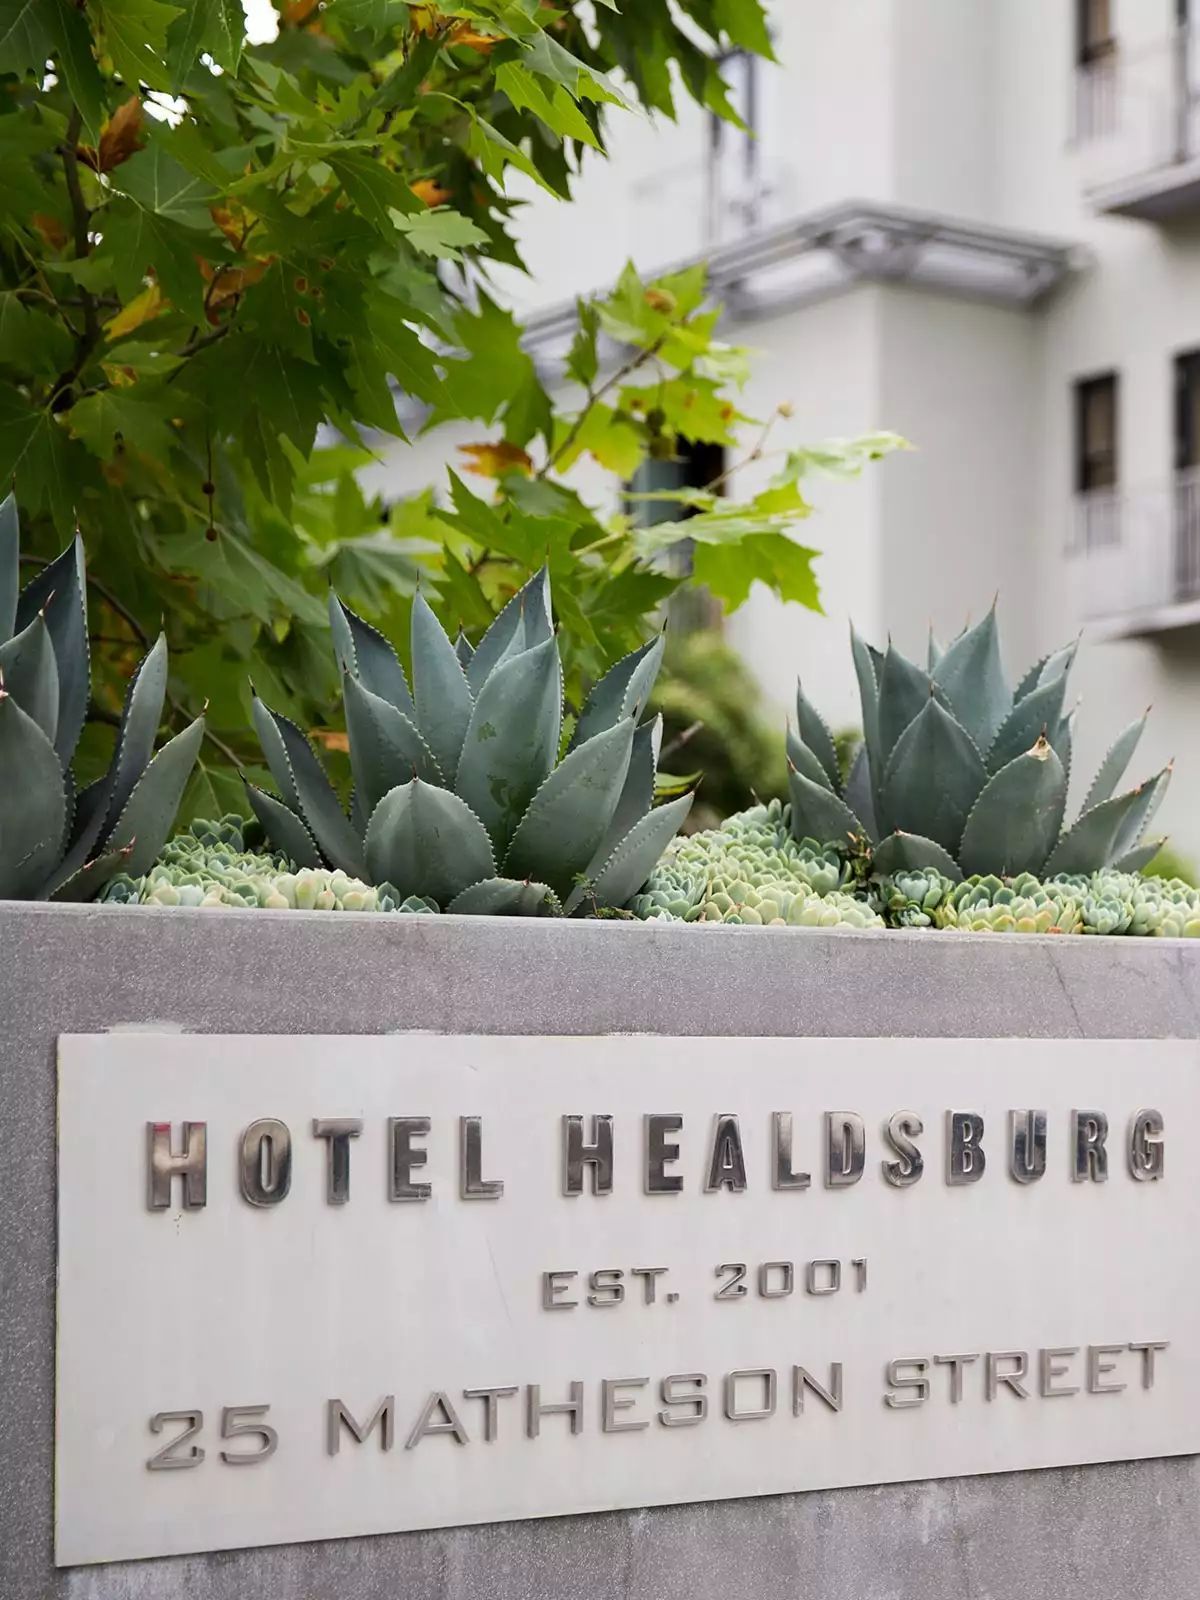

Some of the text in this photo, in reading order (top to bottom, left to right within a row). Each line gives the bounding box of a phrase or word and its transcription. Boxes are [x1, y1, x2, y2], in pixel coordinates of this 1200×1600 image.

[145, 1107, 1166, 1211] HOTEL HEALDSBURG
[541, 1256, 869, 1310] EST. 2001
[146, 1340, 1170, 1472] 25 MATHESON STREET
